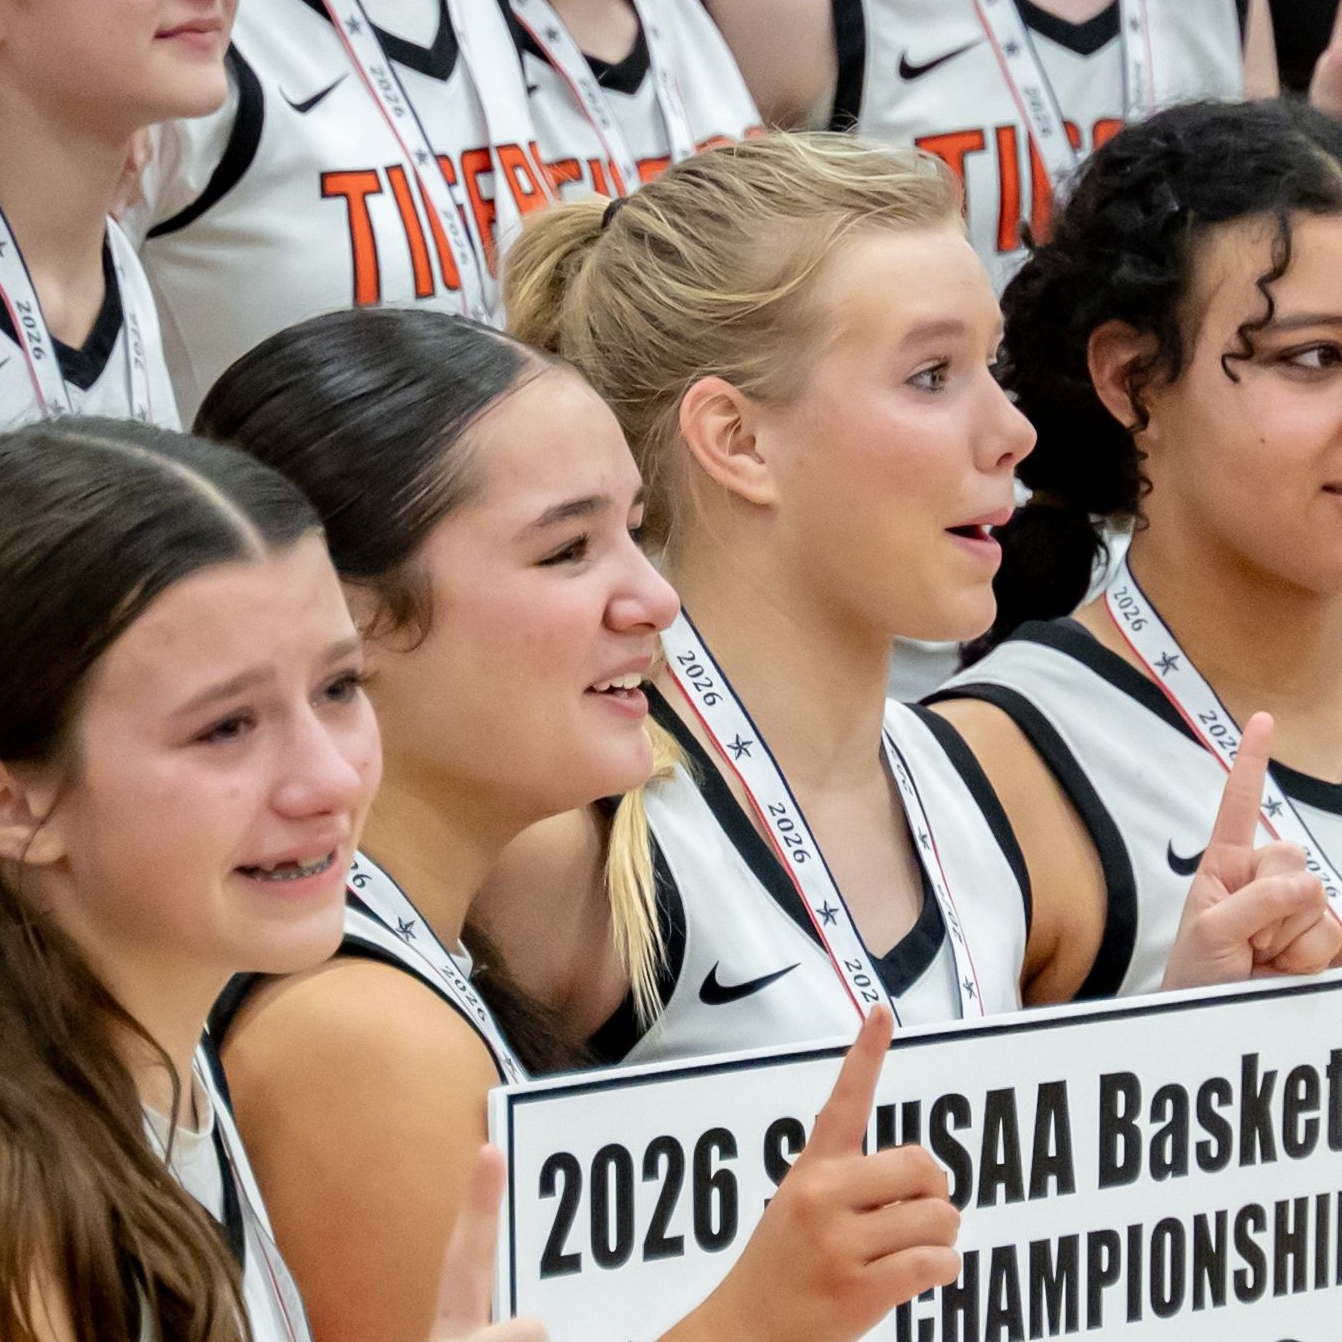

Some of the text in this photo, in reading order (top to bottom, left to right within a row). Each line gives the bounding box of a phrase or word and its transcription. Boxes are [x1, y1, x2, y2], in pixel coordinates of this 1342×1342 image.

[370, 66, 405, 119] 2026
[15, 299, 47, 361] 2026
[1113, 585, 1149, 633] 2026
[677, 649, 724, 707] 2026
[768, 802, 812, 864] 2026
[440, 965, 488, 1023] 2026
[845, 959, 880, 1004] 202
[539, 1127, 740, 1280] 2026
